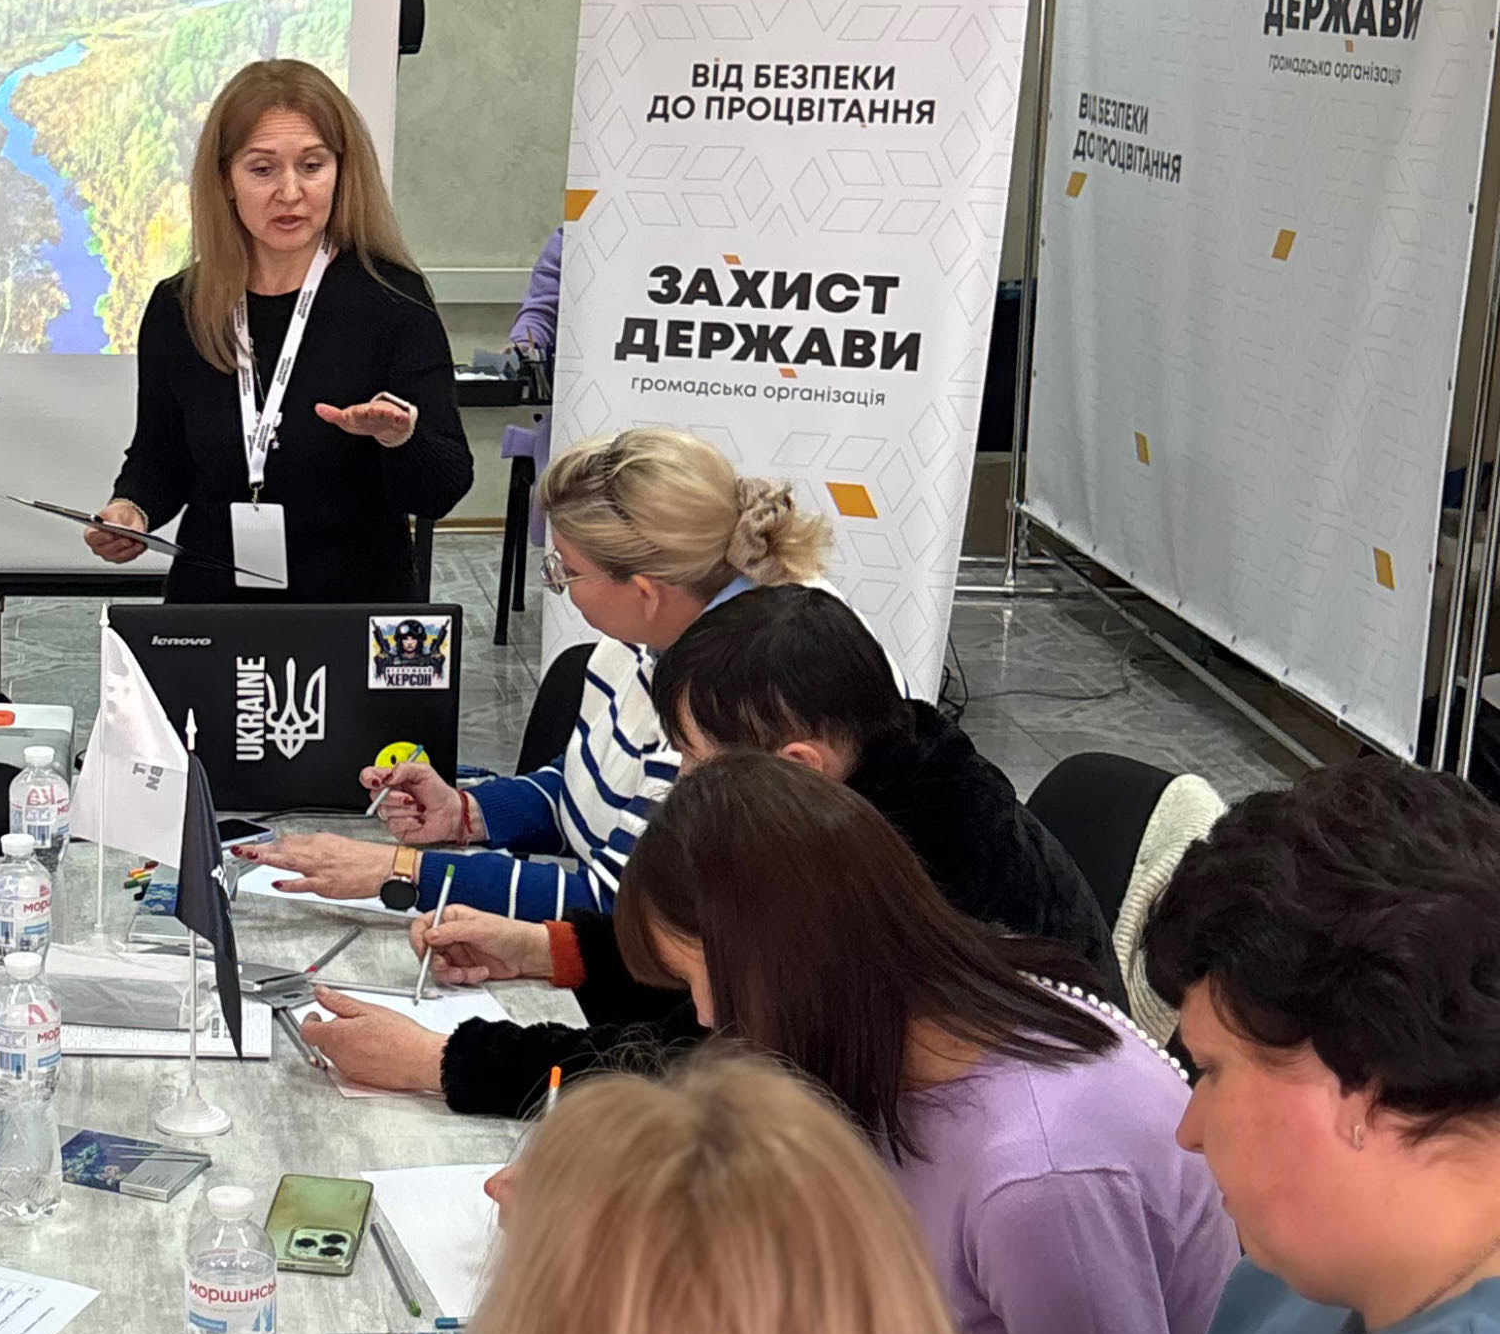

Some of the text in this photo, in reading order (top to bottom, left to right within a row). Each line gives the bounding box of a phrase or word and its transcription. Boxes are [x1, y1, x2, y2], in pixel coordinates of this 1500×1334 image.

[691, 63, 896, 93] ВІД БЕЗПЕКИ
[1269, 53, 1331, 77] громадська
[646, 95, 936, 125] ДО ПРОЦВІТАННЯ
[647, 265, 900, 315] ЗАХИСТ
[614, 317, 923, 372] ДЕРЖАВИ
[631, 375, 886, 407] громадська організація
[151, 635, 212, 646] lenovo
[236, 656, 266, 761] UKRAINE
[190, 1278, 277, 1304] моршинсь
